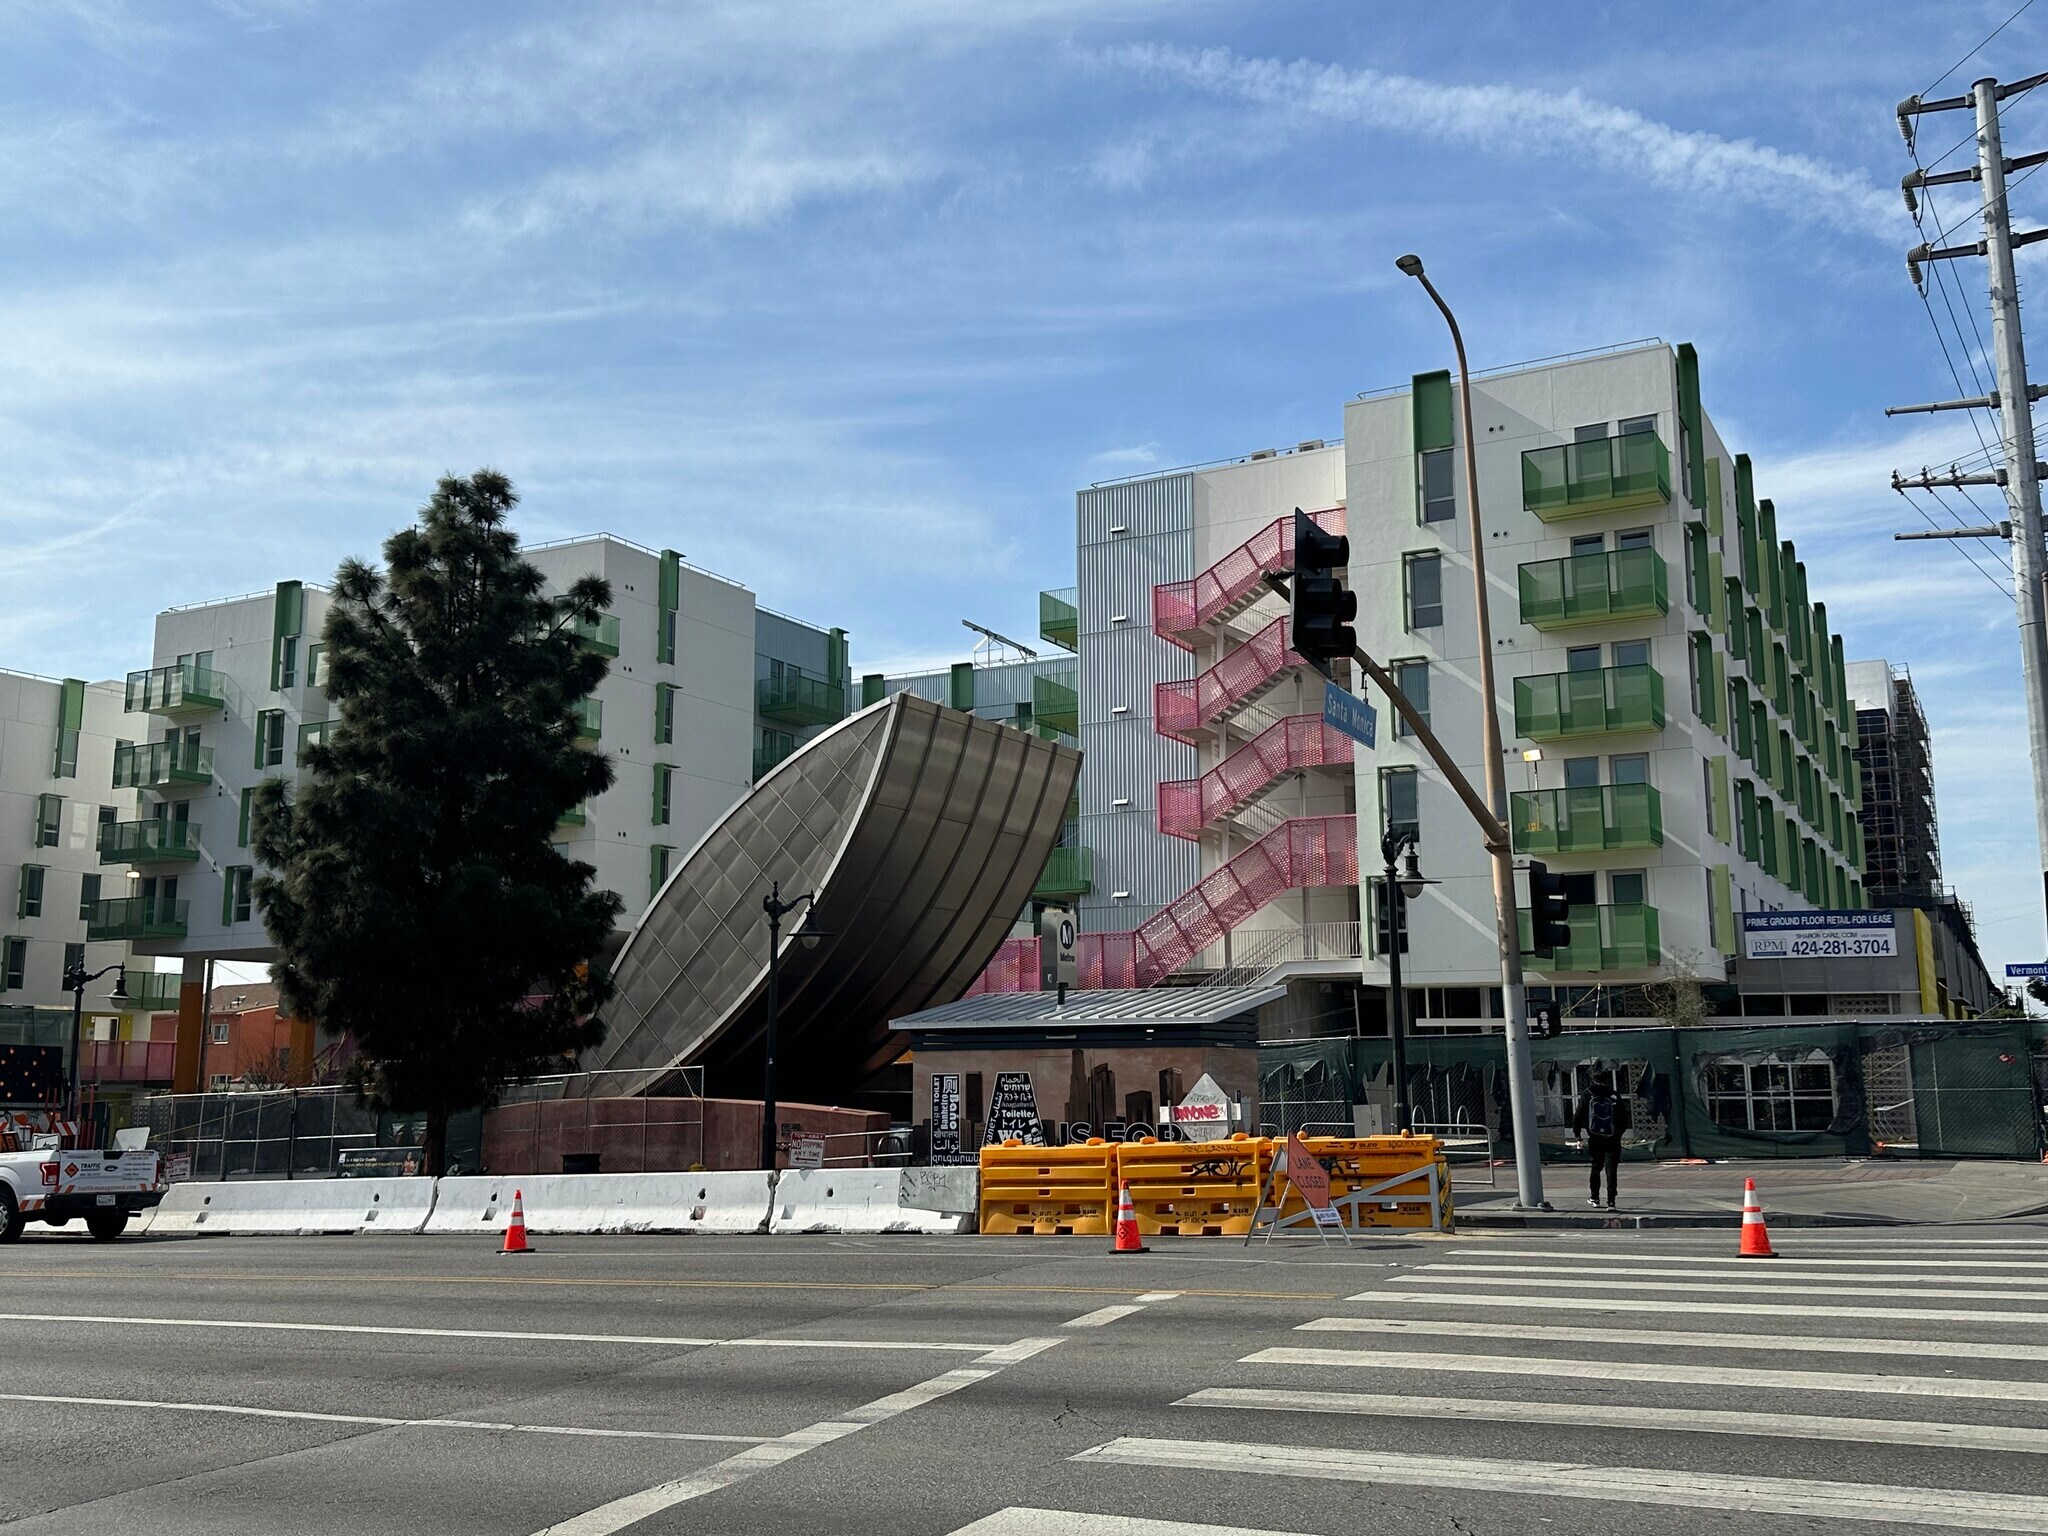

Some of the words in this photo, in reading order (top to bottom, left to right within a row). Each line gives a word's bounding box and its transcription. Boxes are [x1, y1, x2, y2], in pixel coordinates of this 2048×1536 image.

[1328, 693, 1348, 723] Santa
[1351, 708, 1374, 738] Monica
[1746, 918, 1768, 927] PRIME
[1770, 917, 1800, 926] GROUND
[1802, 916, 1824, 925] FLOOR
[1827, 915, 1851, 924] RETAIL
[1852, 915, 1867, 924] FOR
[1869, 914, 1892, 924] LEASE
[1754, 940, 1784, 951] RPM
[1792, 939, 1890, 956] 424-281-3704
[1060, 952, 1075, 962] Metro
[2010, 965, 2048, 975] Vermont
[940, 1094, 948, 1130] Banheiro
[1002, 1110, 1035, 1118] Toilettes
[1002, 1119, 1026, 1129] トイレ
[998, 1130, 1023, 1142] WC
[792, 1140, 801, 1149] NO
[1293, 1156, 1314, 1170] LANE
[1296, 1175, 1326, 1189] CLOSED
